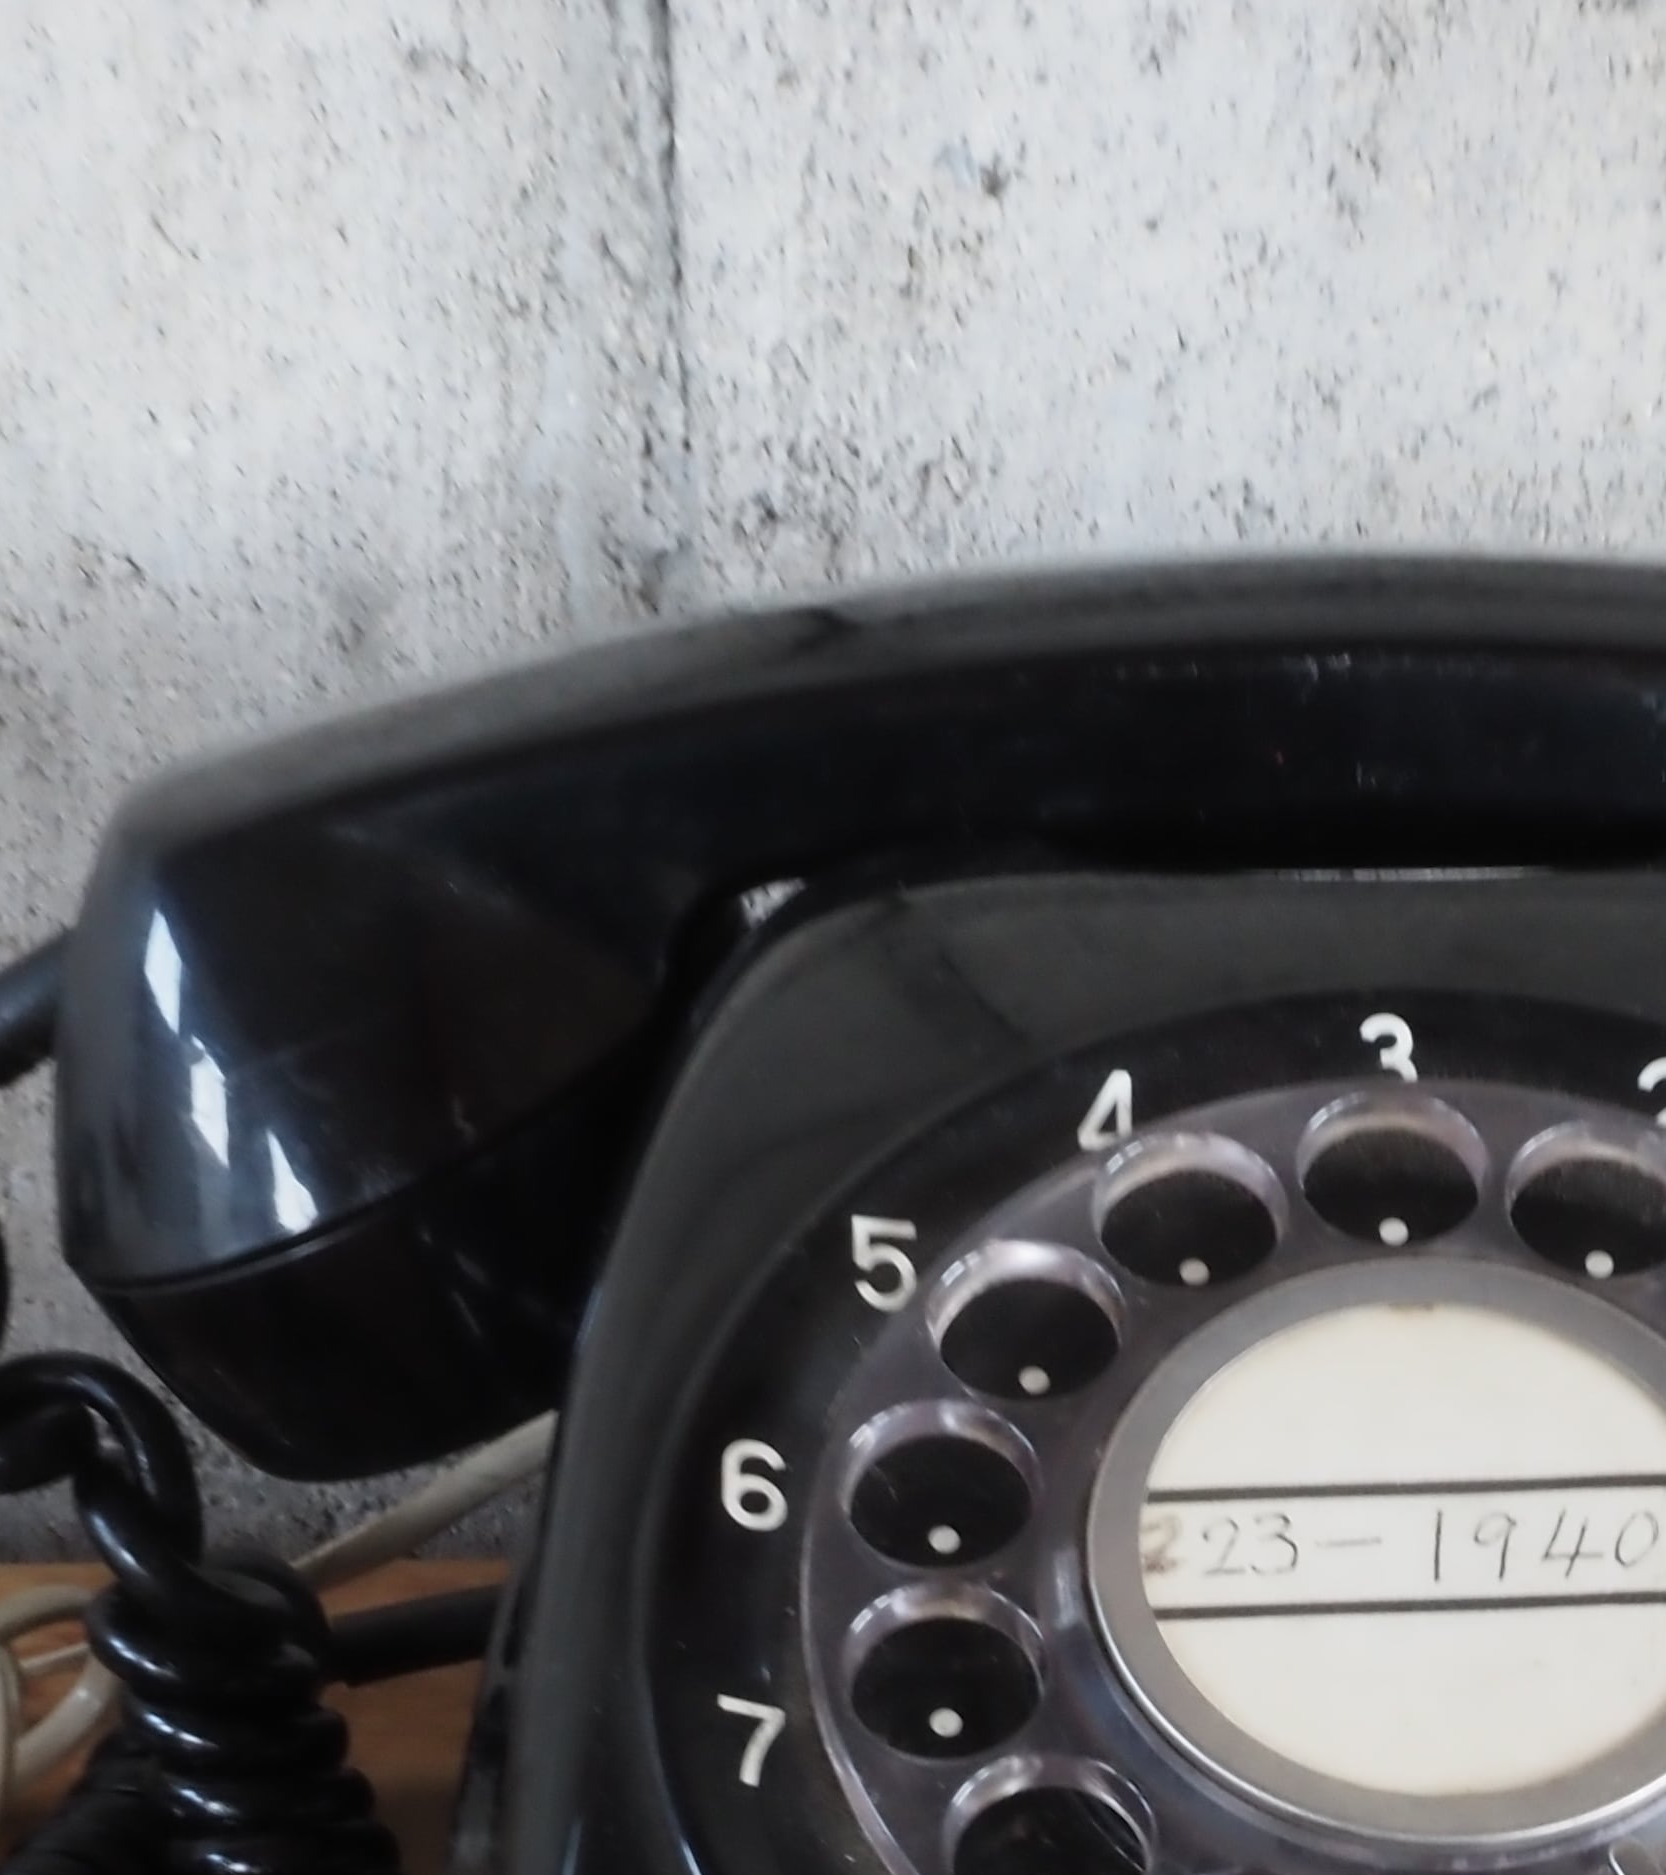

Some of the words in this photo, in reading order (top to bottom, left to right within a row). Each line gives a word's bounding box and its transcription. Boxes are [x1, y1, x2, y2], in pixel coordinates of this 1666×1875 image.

[1359, 1012, 1418, 1083] 3
[1077, 1068, 1133, 1151] 4
[850, 1214, 918, 1312] 5
[721, 1438, 788, 1532] 6
[715, 1692, 786, 1787] 7
